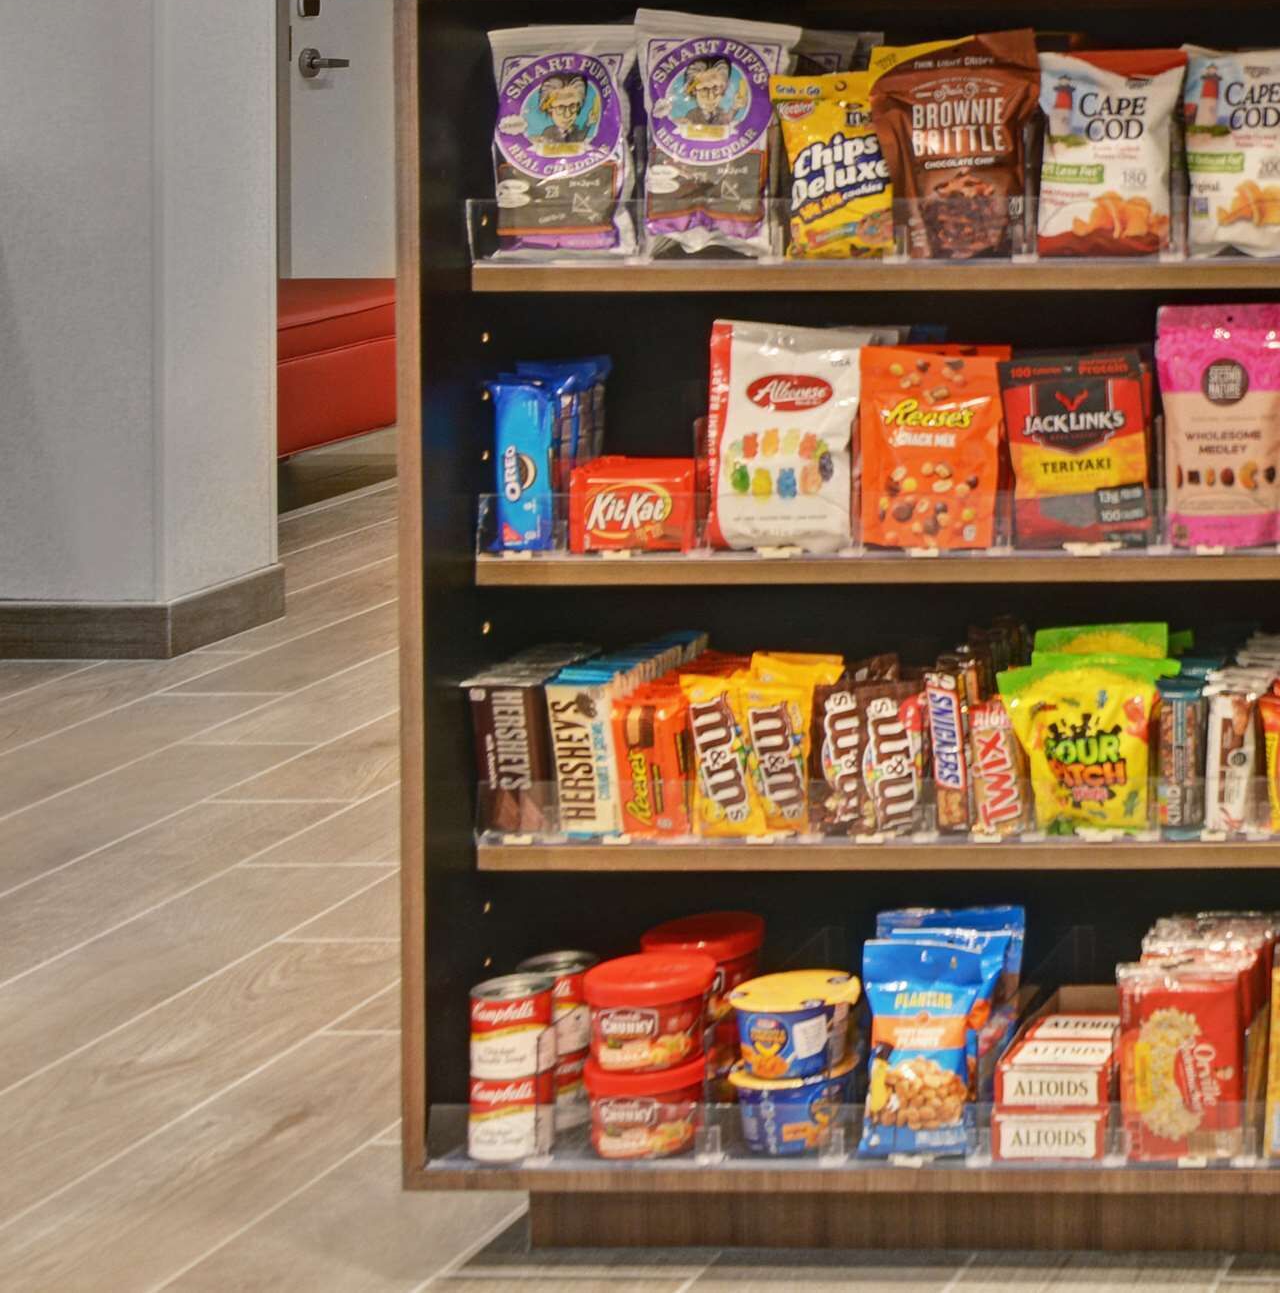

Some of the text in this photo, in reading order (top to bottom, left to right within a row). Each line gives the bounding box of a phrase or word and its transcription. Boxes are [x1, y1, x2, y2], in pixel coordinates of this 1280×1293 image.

[652, 39, 769, 85] SMART PUFFS
[507, 56, 613, 100] SMART PUFFS
[912, 97, 1005, 130] BROWNIE
[1079, 92, 1148, 117] CAPE
[655, 126, 759, 161] REAL CHEDDAR
[912, 126, 1006, 157] BRITTLE
[1085, 118, 1144, 142] COD
[507, 143, 540, 173] REAL
[793, 133, 879, 180] Chips
[924, 157, 974, 170] CHOCOLATE
[790, 158, 891, 212] Deluxe
[1208, 383, 1243, 399] NATURE
[1023, 412, 1069, 435] JACK
[1184, 430, 1263, 441] WHOLESOME
[1198, 444, 1249, 455] MEDLEY
[505, 445, 522, 502] OREO
[1041, 457, 1113, 474] TERIYAKI
[929, 692, 961, 786] SNICKERS
[1046, 734, 1122, 765] SOUR
[1168, 785, 1182, 826] KIND
[601, 1017, 654, 1036] CHUNKY
[1013, 1079, 1089, 1097] ALTOIDS
[1011, 1129, 1087, 1148] ALTOIDS
